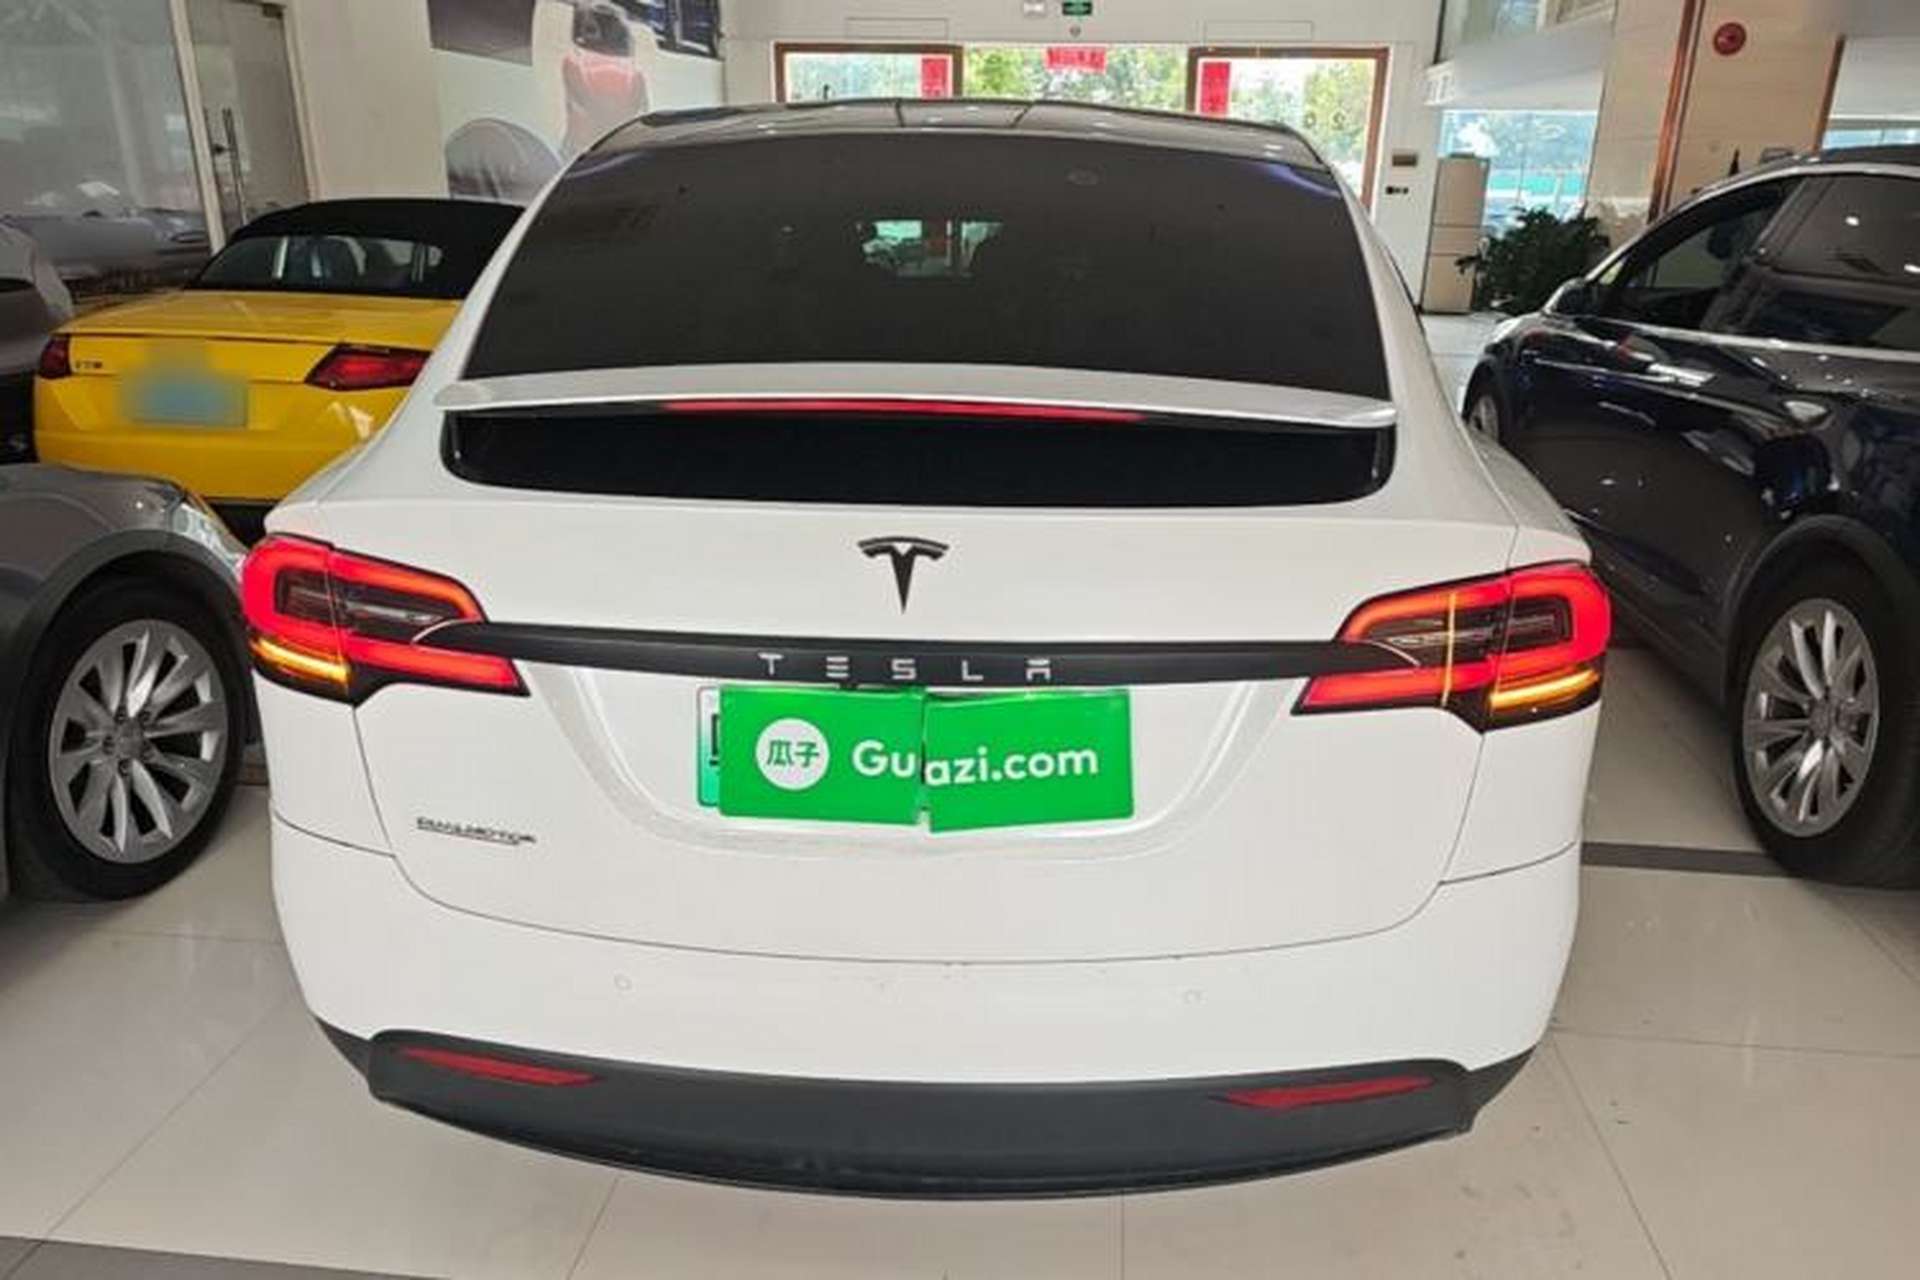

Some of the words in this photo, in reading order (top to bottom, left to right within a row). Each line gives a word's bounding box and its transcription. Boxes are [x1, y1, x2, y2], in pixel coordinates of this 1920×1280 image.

[758, 652, 1053, 682] TESLA
[766, 739, 820, 768] 瓜子
[851, 739, 1099, 786] Guazi.com
